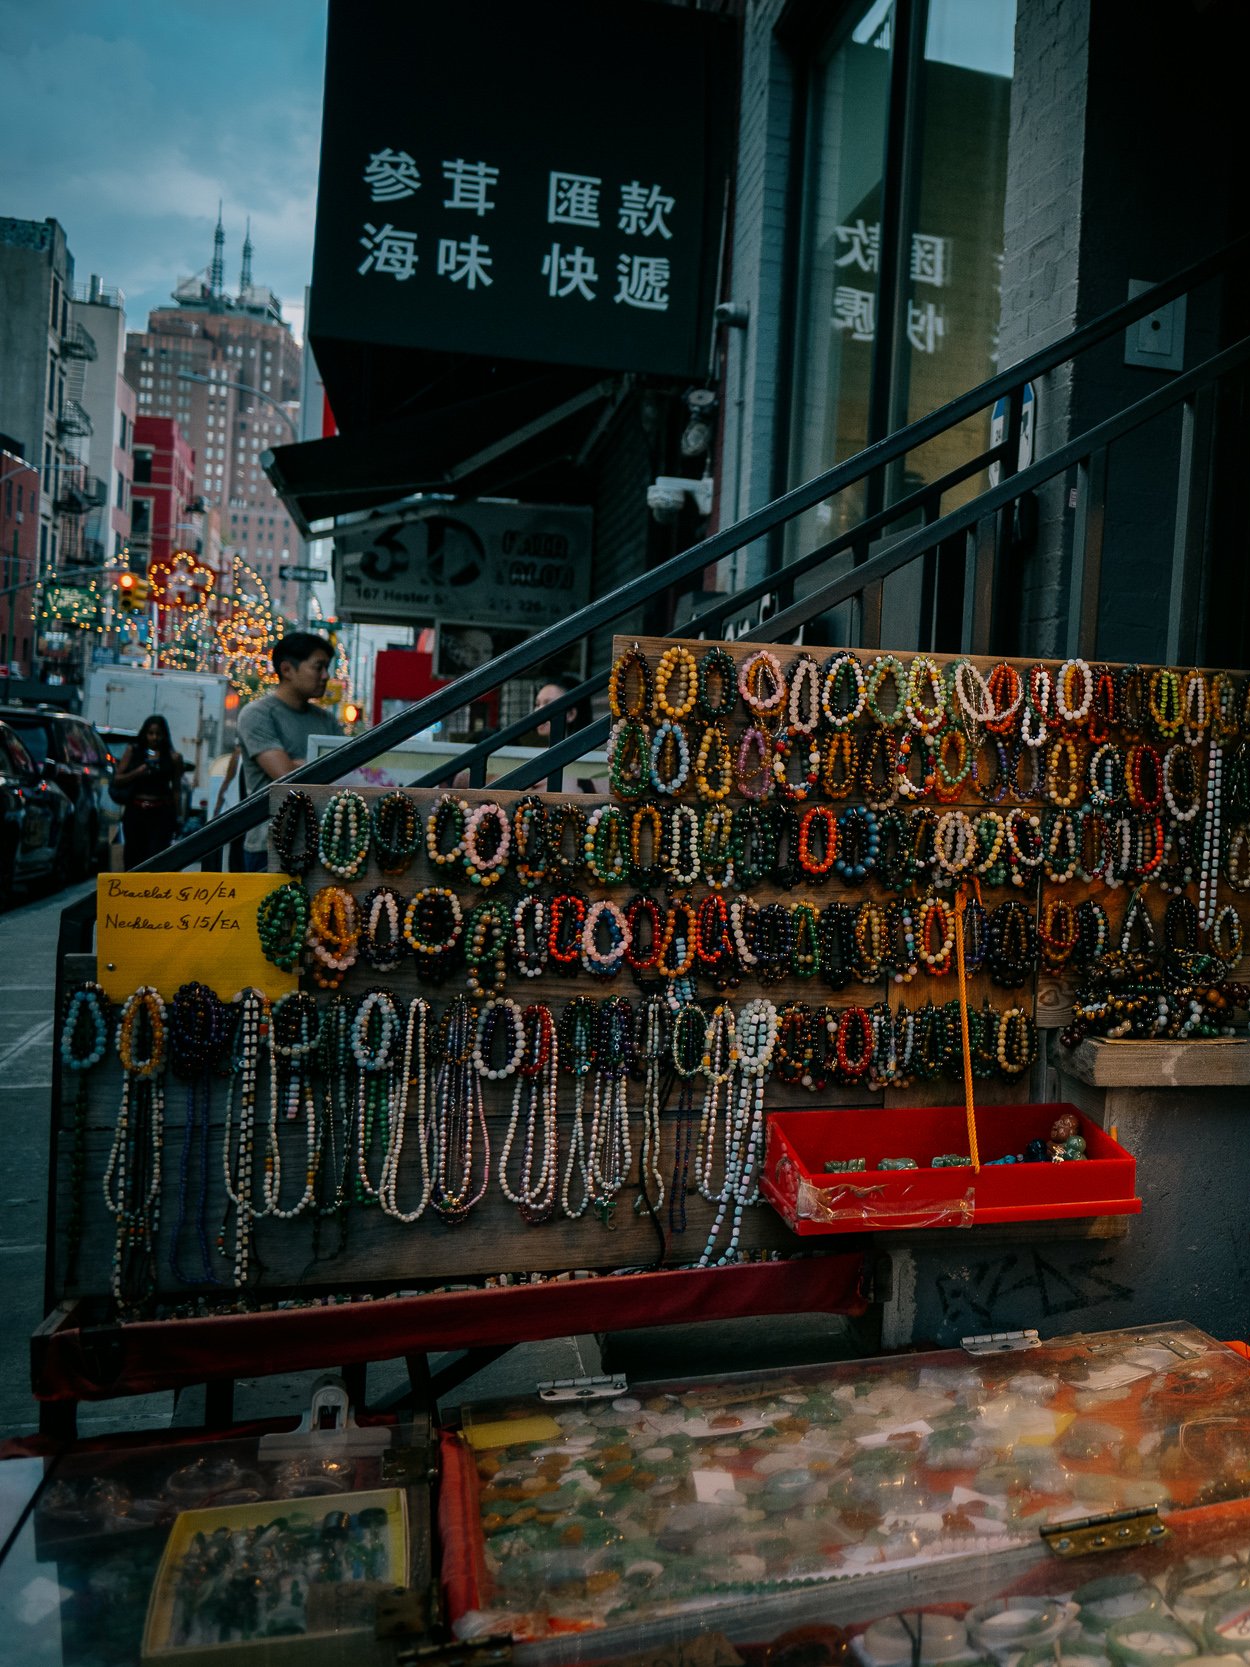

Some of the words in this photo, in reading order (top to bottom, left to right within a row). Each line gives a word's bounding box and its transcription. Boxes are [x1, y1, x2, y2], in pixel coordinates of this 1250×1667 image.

[362, 147, 499, 216] 參茸
[547, 171, 675, 239] 匯款
[358, 223, 494, 290] 海味
[541, 242, 671, 311] 快遞
[105, 913, 173, 930] Necklace
